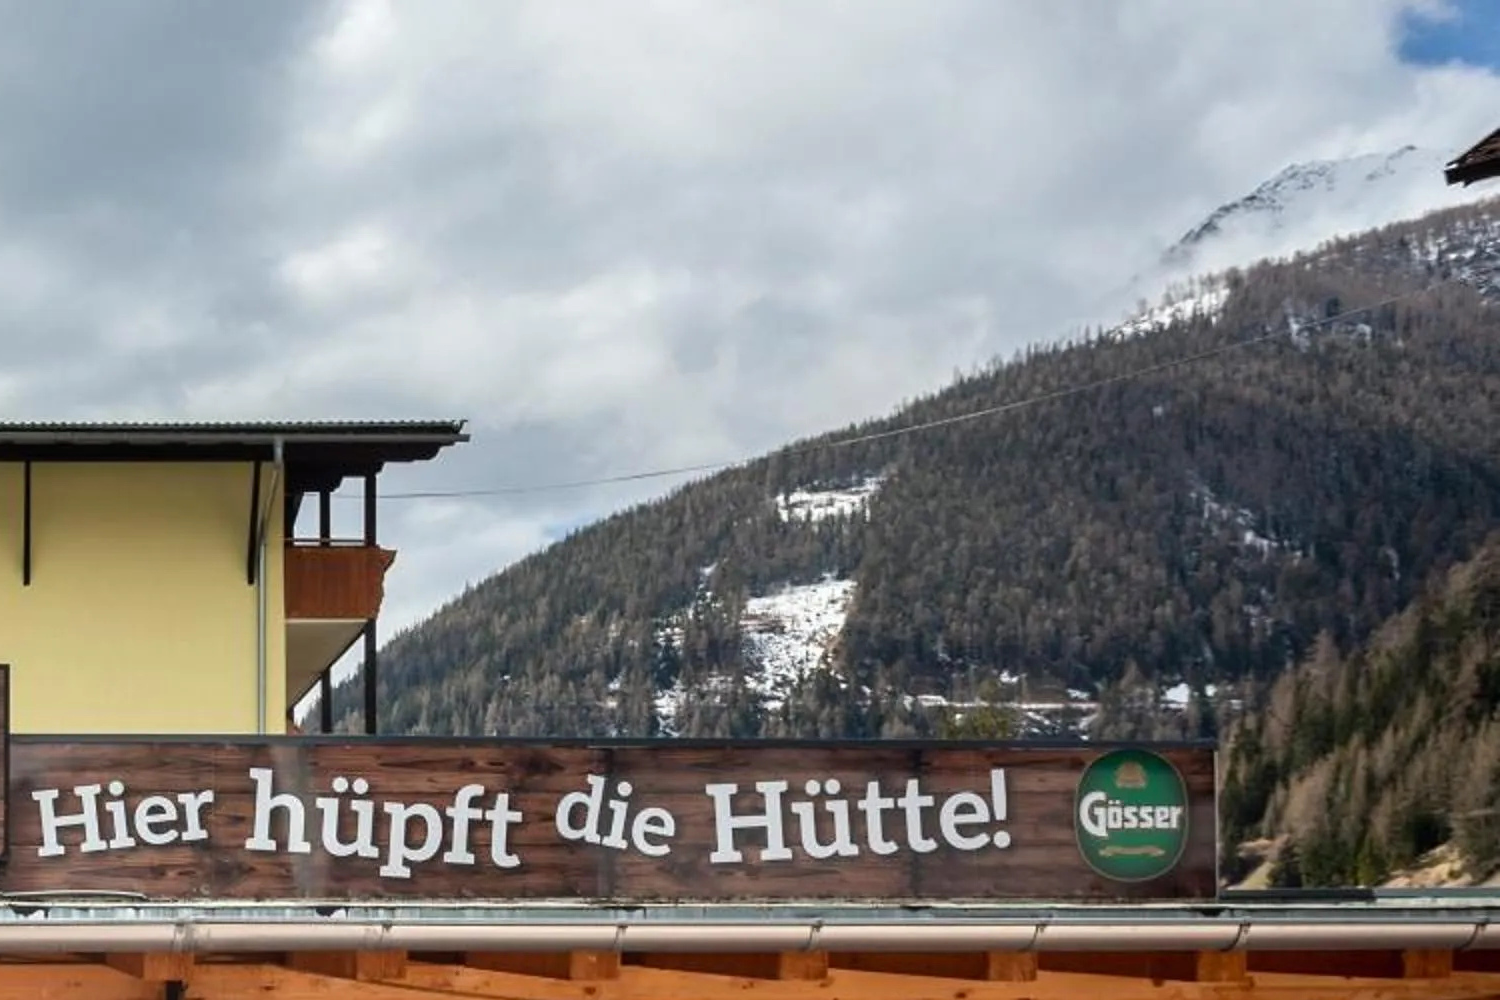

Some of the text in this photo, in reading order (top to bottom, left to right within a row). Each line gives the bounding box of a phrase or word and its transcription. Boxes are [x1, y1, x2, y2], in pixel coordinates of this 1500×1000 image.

[31, 767, 1011, 878] Hier hüpft die Hütte!
[1079, 790, 1184, 837] Gösser
